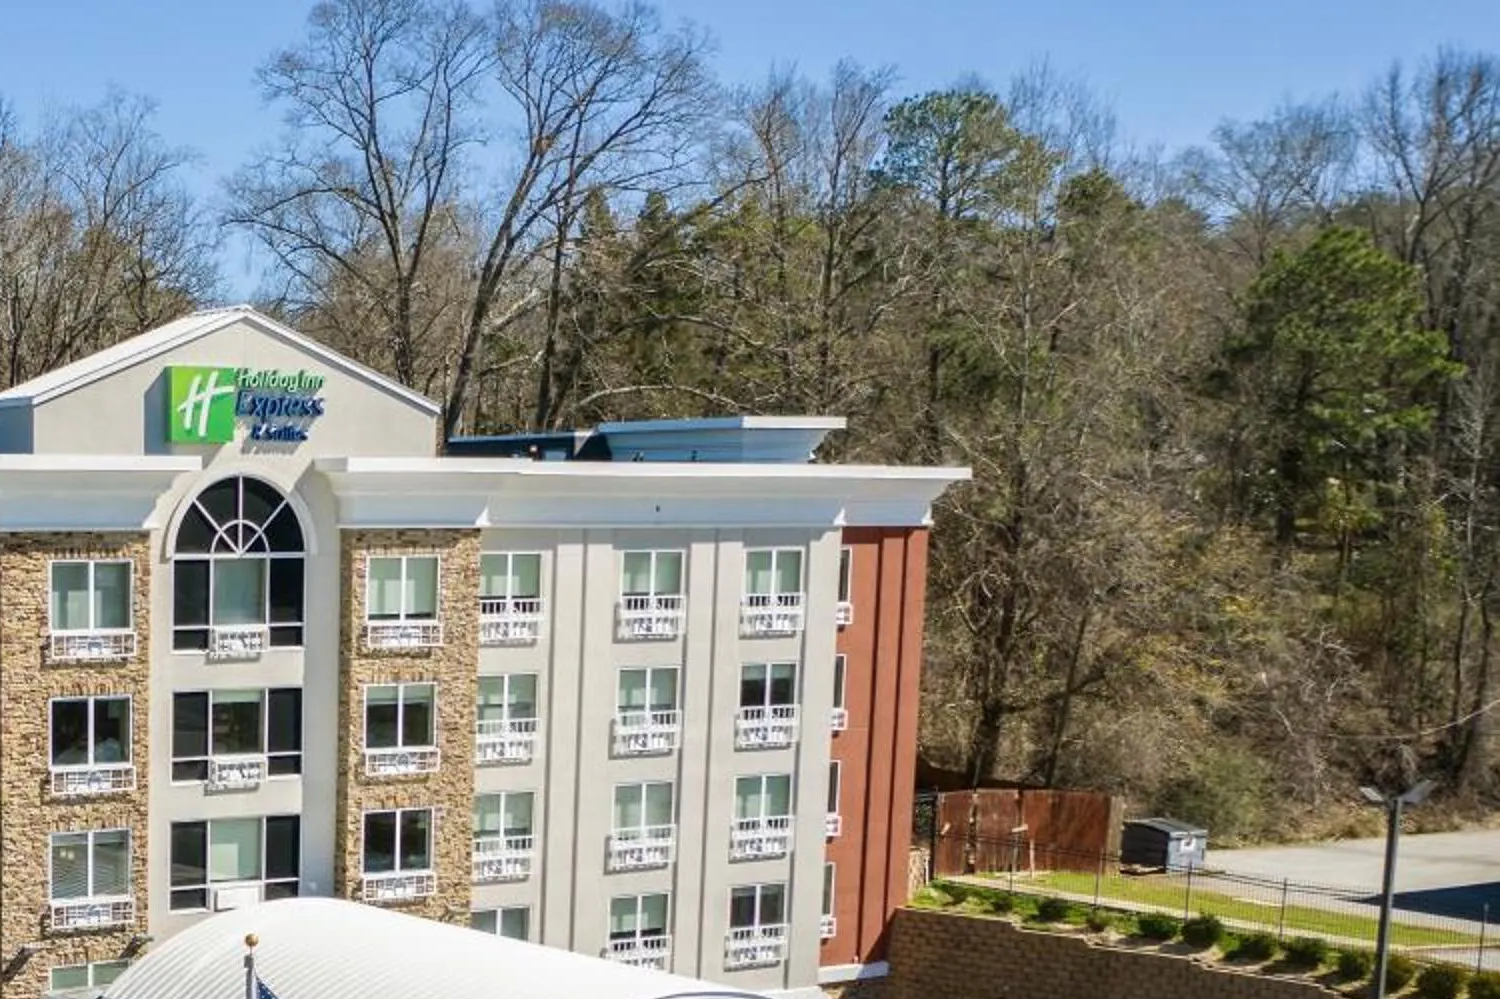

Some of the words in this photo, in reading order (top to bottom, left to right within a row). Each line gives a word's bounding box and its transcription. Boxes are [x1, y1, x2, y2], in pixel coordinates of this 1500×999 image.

[237, 368, 299, 392] Holiday
[298, 370, 325, 390] Inn
[236, 391, 325, 423] Express
